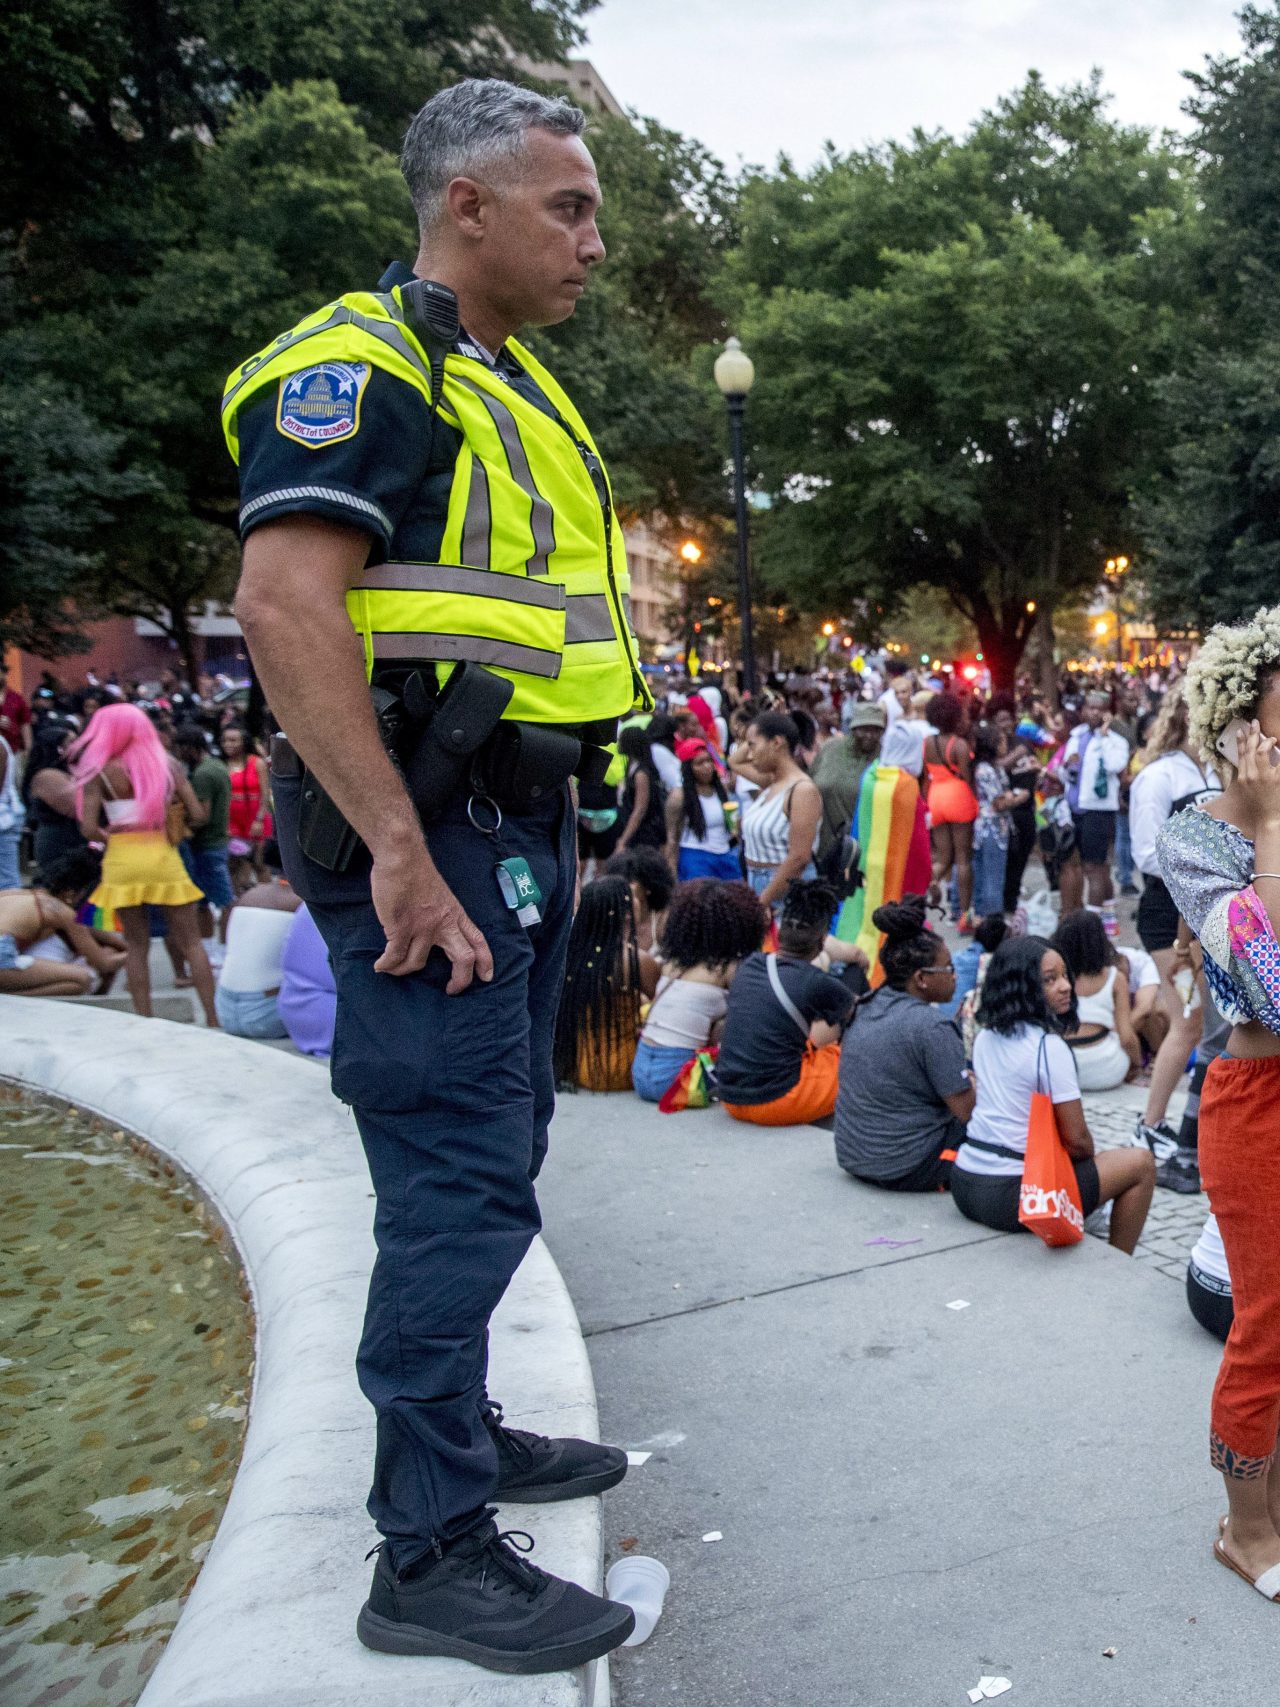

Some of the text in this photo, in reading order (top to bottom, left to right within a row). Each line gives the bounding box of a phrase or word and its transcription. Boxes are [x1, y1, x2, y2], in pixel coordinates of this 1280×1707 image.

[284, 418, 310, 435] DISTRICT
[319, 421, 351, 437] COLUMBIA
[519, 884, 535, 897] DC
